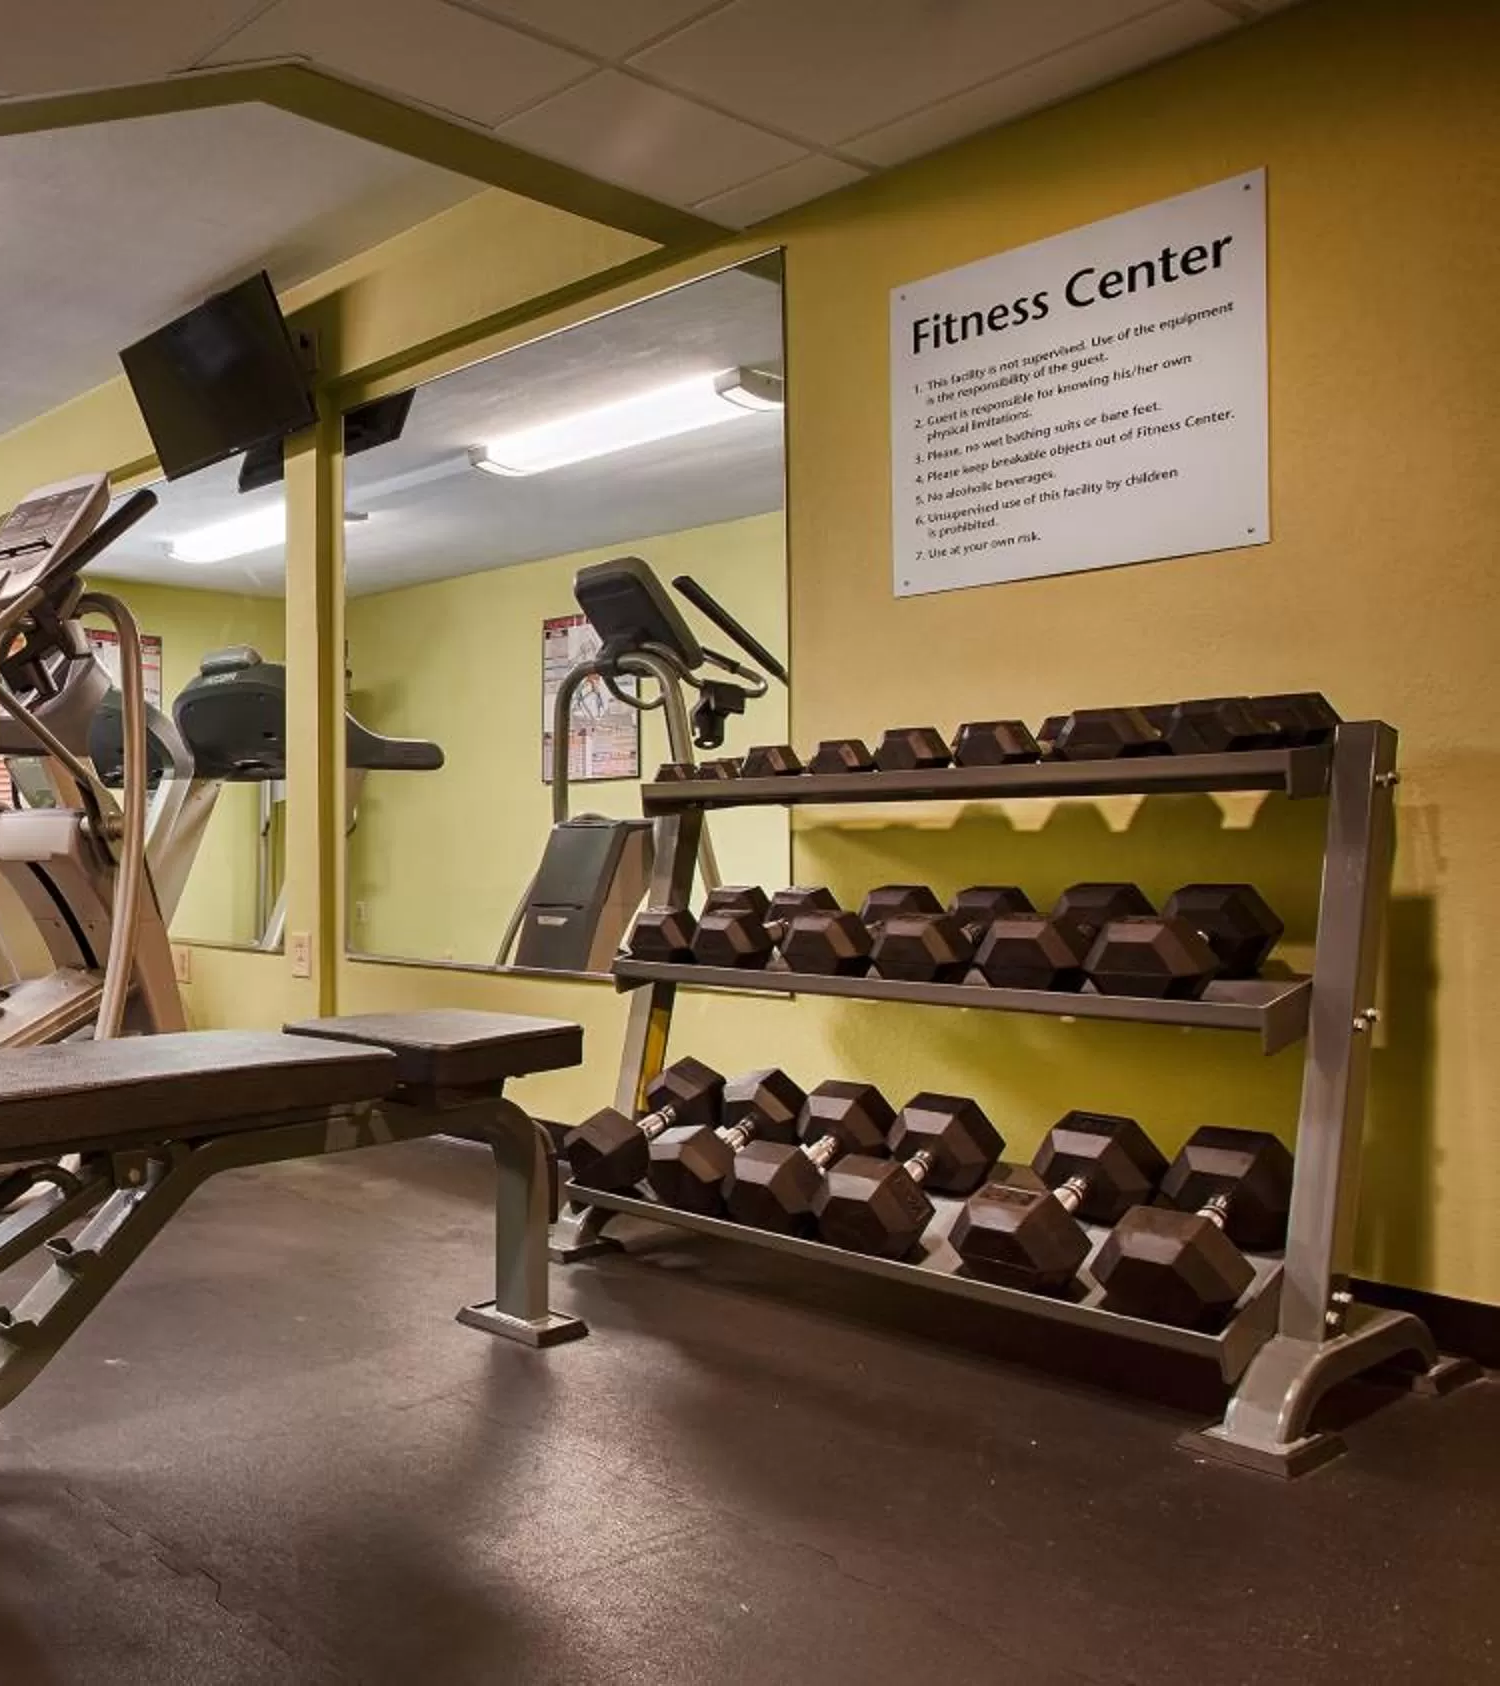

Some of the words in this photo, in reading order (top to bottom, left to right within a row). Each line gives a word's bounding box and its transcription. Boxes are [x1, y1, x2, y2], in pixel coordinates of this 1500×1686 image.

[912, 290, 1049, 355] Fitness
[1064, 234, 1233, 308] Center
[927, 377, 949, 391] This
[950, 367, 985, 384] facility
[999, 358, 1019, 372] not
[1133, 323, 1155, 337] the
[1159, 301, 1234, 331] equipment
[926, 410, 957, 427] Guest
[970, 391, 1035, 416] responsible
[1056, 371, 1110, 395] knowing
[1112, 361, 1159, 382] his/her
[1161, 354, 1192, 369] own
[936, 391, 955, 403] the
[957, 369, 1031, 398] responsibility
[1047, 362, 1068, 375] the
[1070, 351, 1108, 373] guest.
[926, 420, 969, 444] physical
[926, 468, 960, 484] Please
[991, 448, 1047, 469] breakable
[1048, 439, 1093, 461] objects
[1094, 432, 1117, 448] out
[1136, 421, 1181, 439] Fitness
[1183, 409, 1235, 430] Center.
[981, 436, 1004, 449] wet
[1005, 426, 1051, 445] bathing
[1053, 419, 1081, 435] suits
[1100, 409, 1129, 424] bare
[1132, 401, 1162, 416] feet.
[927, 499, 999, 523] Unsupervised
[1001, 499, 1021, 509] use
[1038, 489, 1060, 503] this
[1063, 483, 1103, 499] facility
[1124, 468, 1178, 490] children
[945, 480, 993, 499] alcoholic
[963, 541, 989, 556] your
[990, 535, 1015, 549] own
[1016, 531, 1041, 544] risk.
